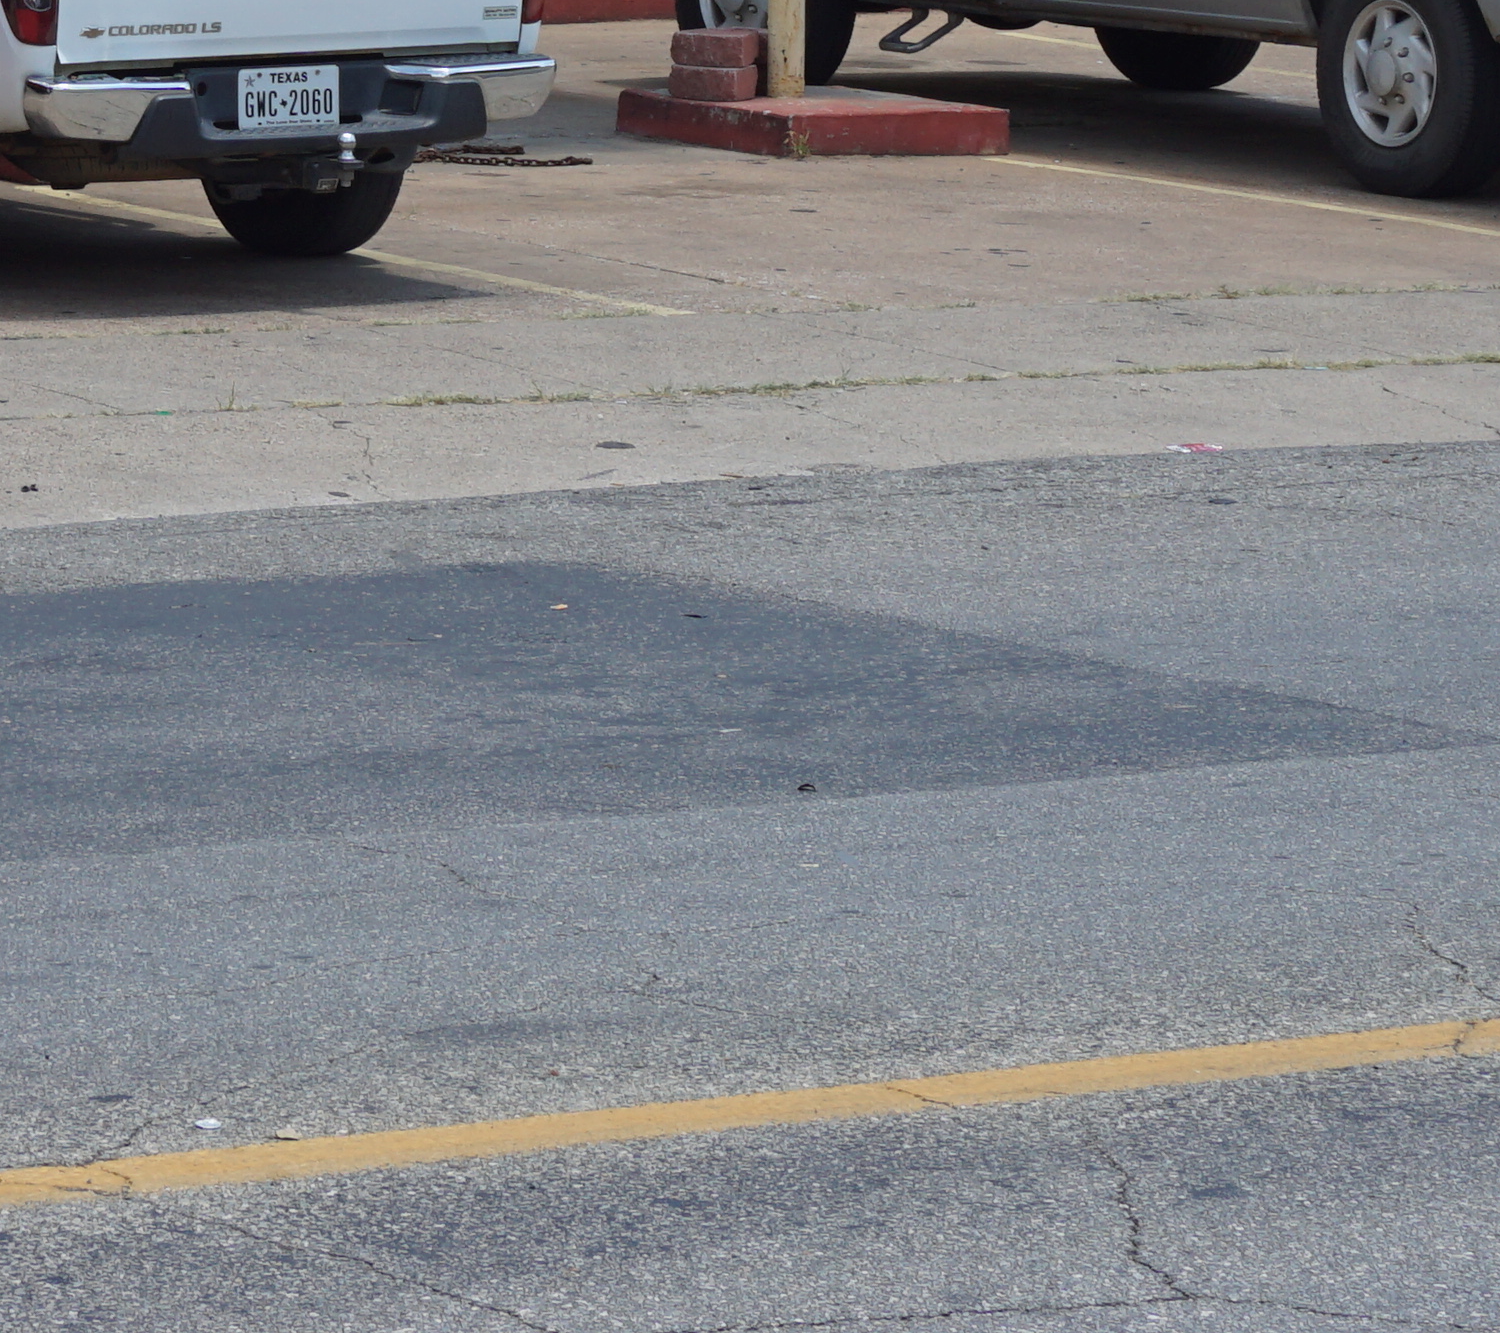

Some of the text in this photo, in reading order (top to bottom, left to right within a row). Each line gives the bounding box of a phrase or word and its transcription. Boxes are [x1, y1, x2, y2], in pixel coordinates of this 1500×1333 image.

[108, 22, 222, 37] COLORADO LS
[270, 72, 308, 83] TEXAS
[245, 88, 333, 118] GWC 2060
